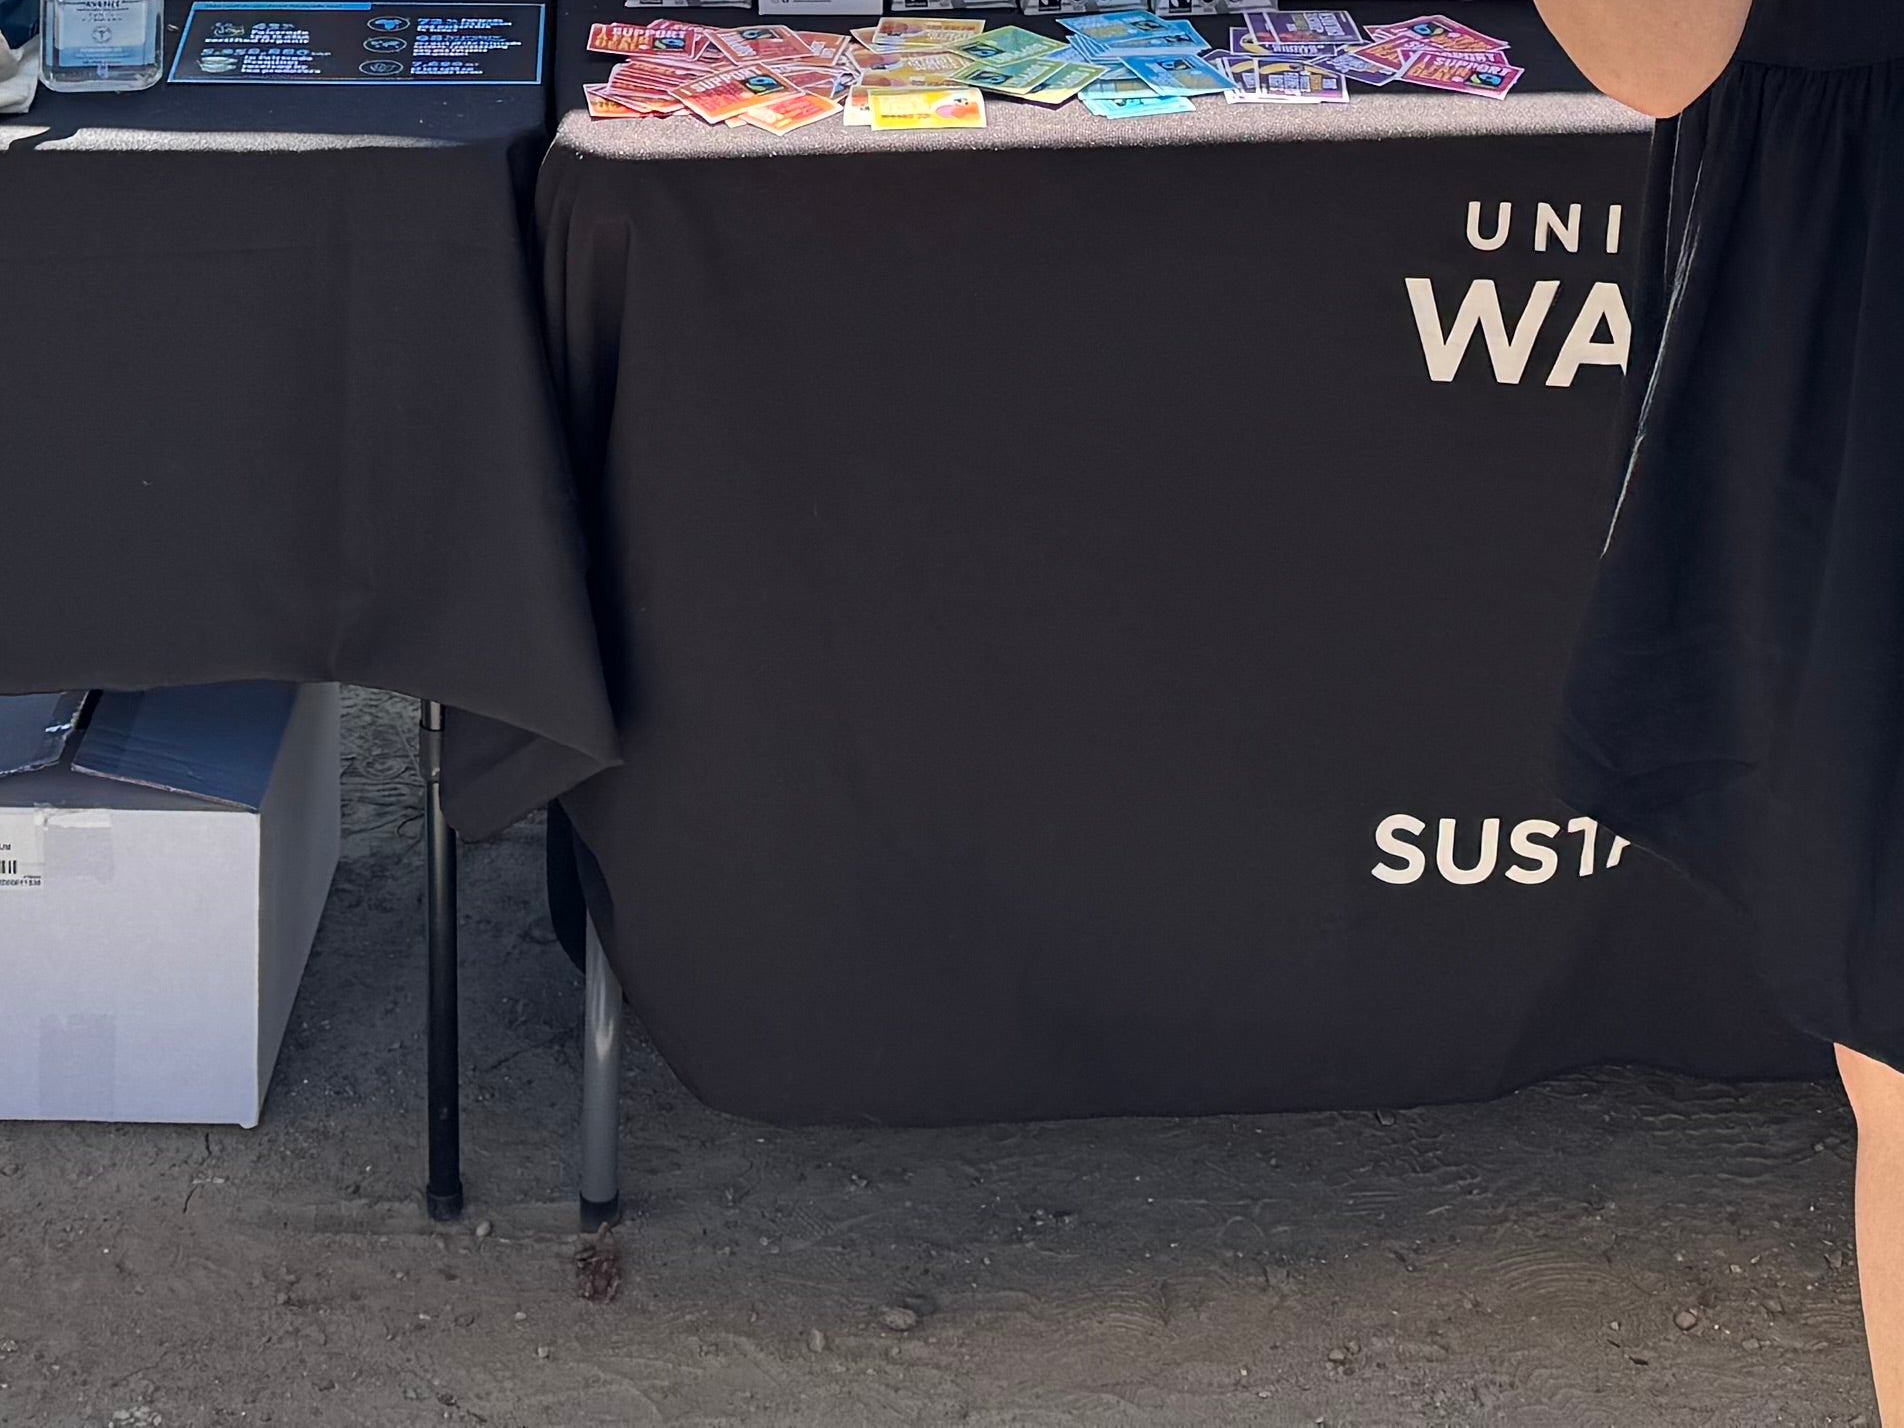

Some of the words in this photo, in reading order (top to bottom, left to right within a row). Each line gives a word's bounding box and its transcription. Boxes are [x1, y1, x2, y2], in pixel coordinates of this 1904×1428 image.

[1433, 55, 1512, 76] SUPPORT
[1465, 201, 1623, 254] UNI
[1404, 276, 1633, 388] WA
[1371, 813, 1632, 887] SUST
